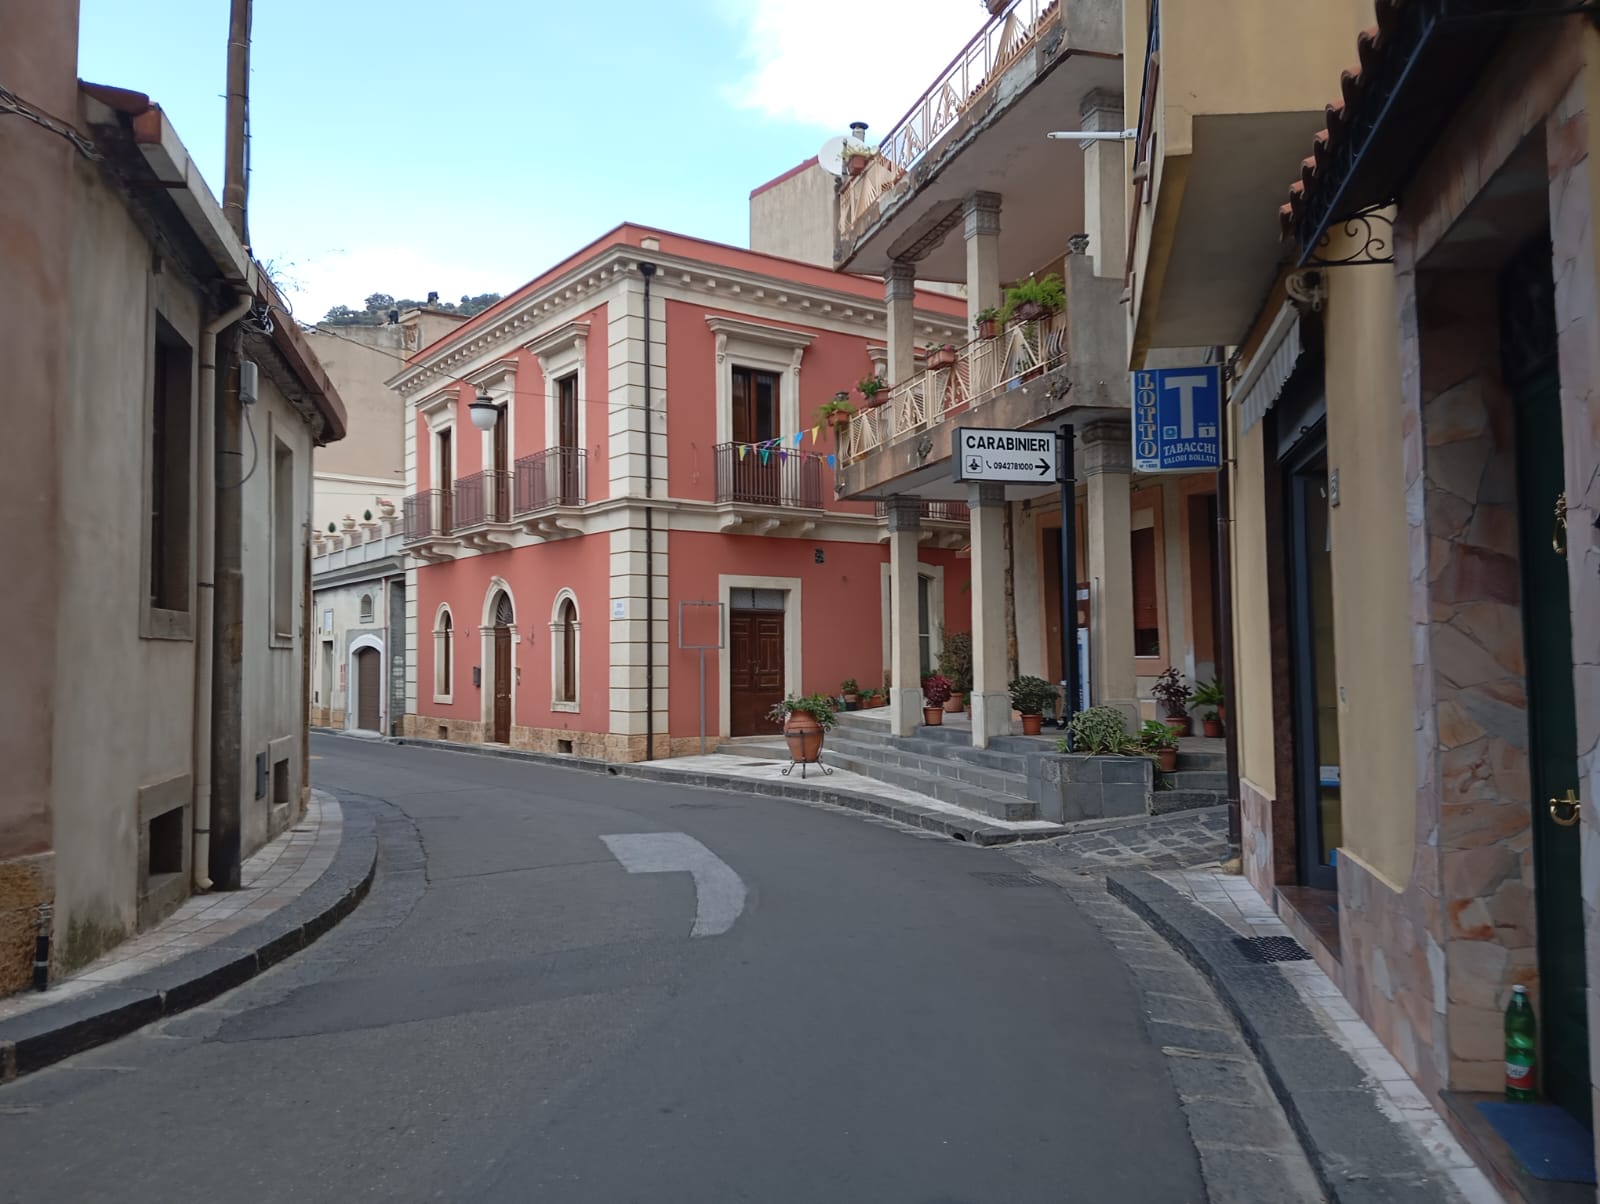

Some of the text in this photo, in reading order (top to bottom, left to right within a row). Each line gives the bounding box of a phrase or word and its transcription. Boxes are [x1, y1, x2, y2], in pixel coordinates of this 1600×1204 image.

[1137, 373, 1157, 457] LOTTO
[1164, 375, 1208, 439] T
[966, 436, 1050, 452] CARABINIERI
[1163, 442, 1216, 456] TABACCHI
[993, 462, 1034, 471] 0942781000
